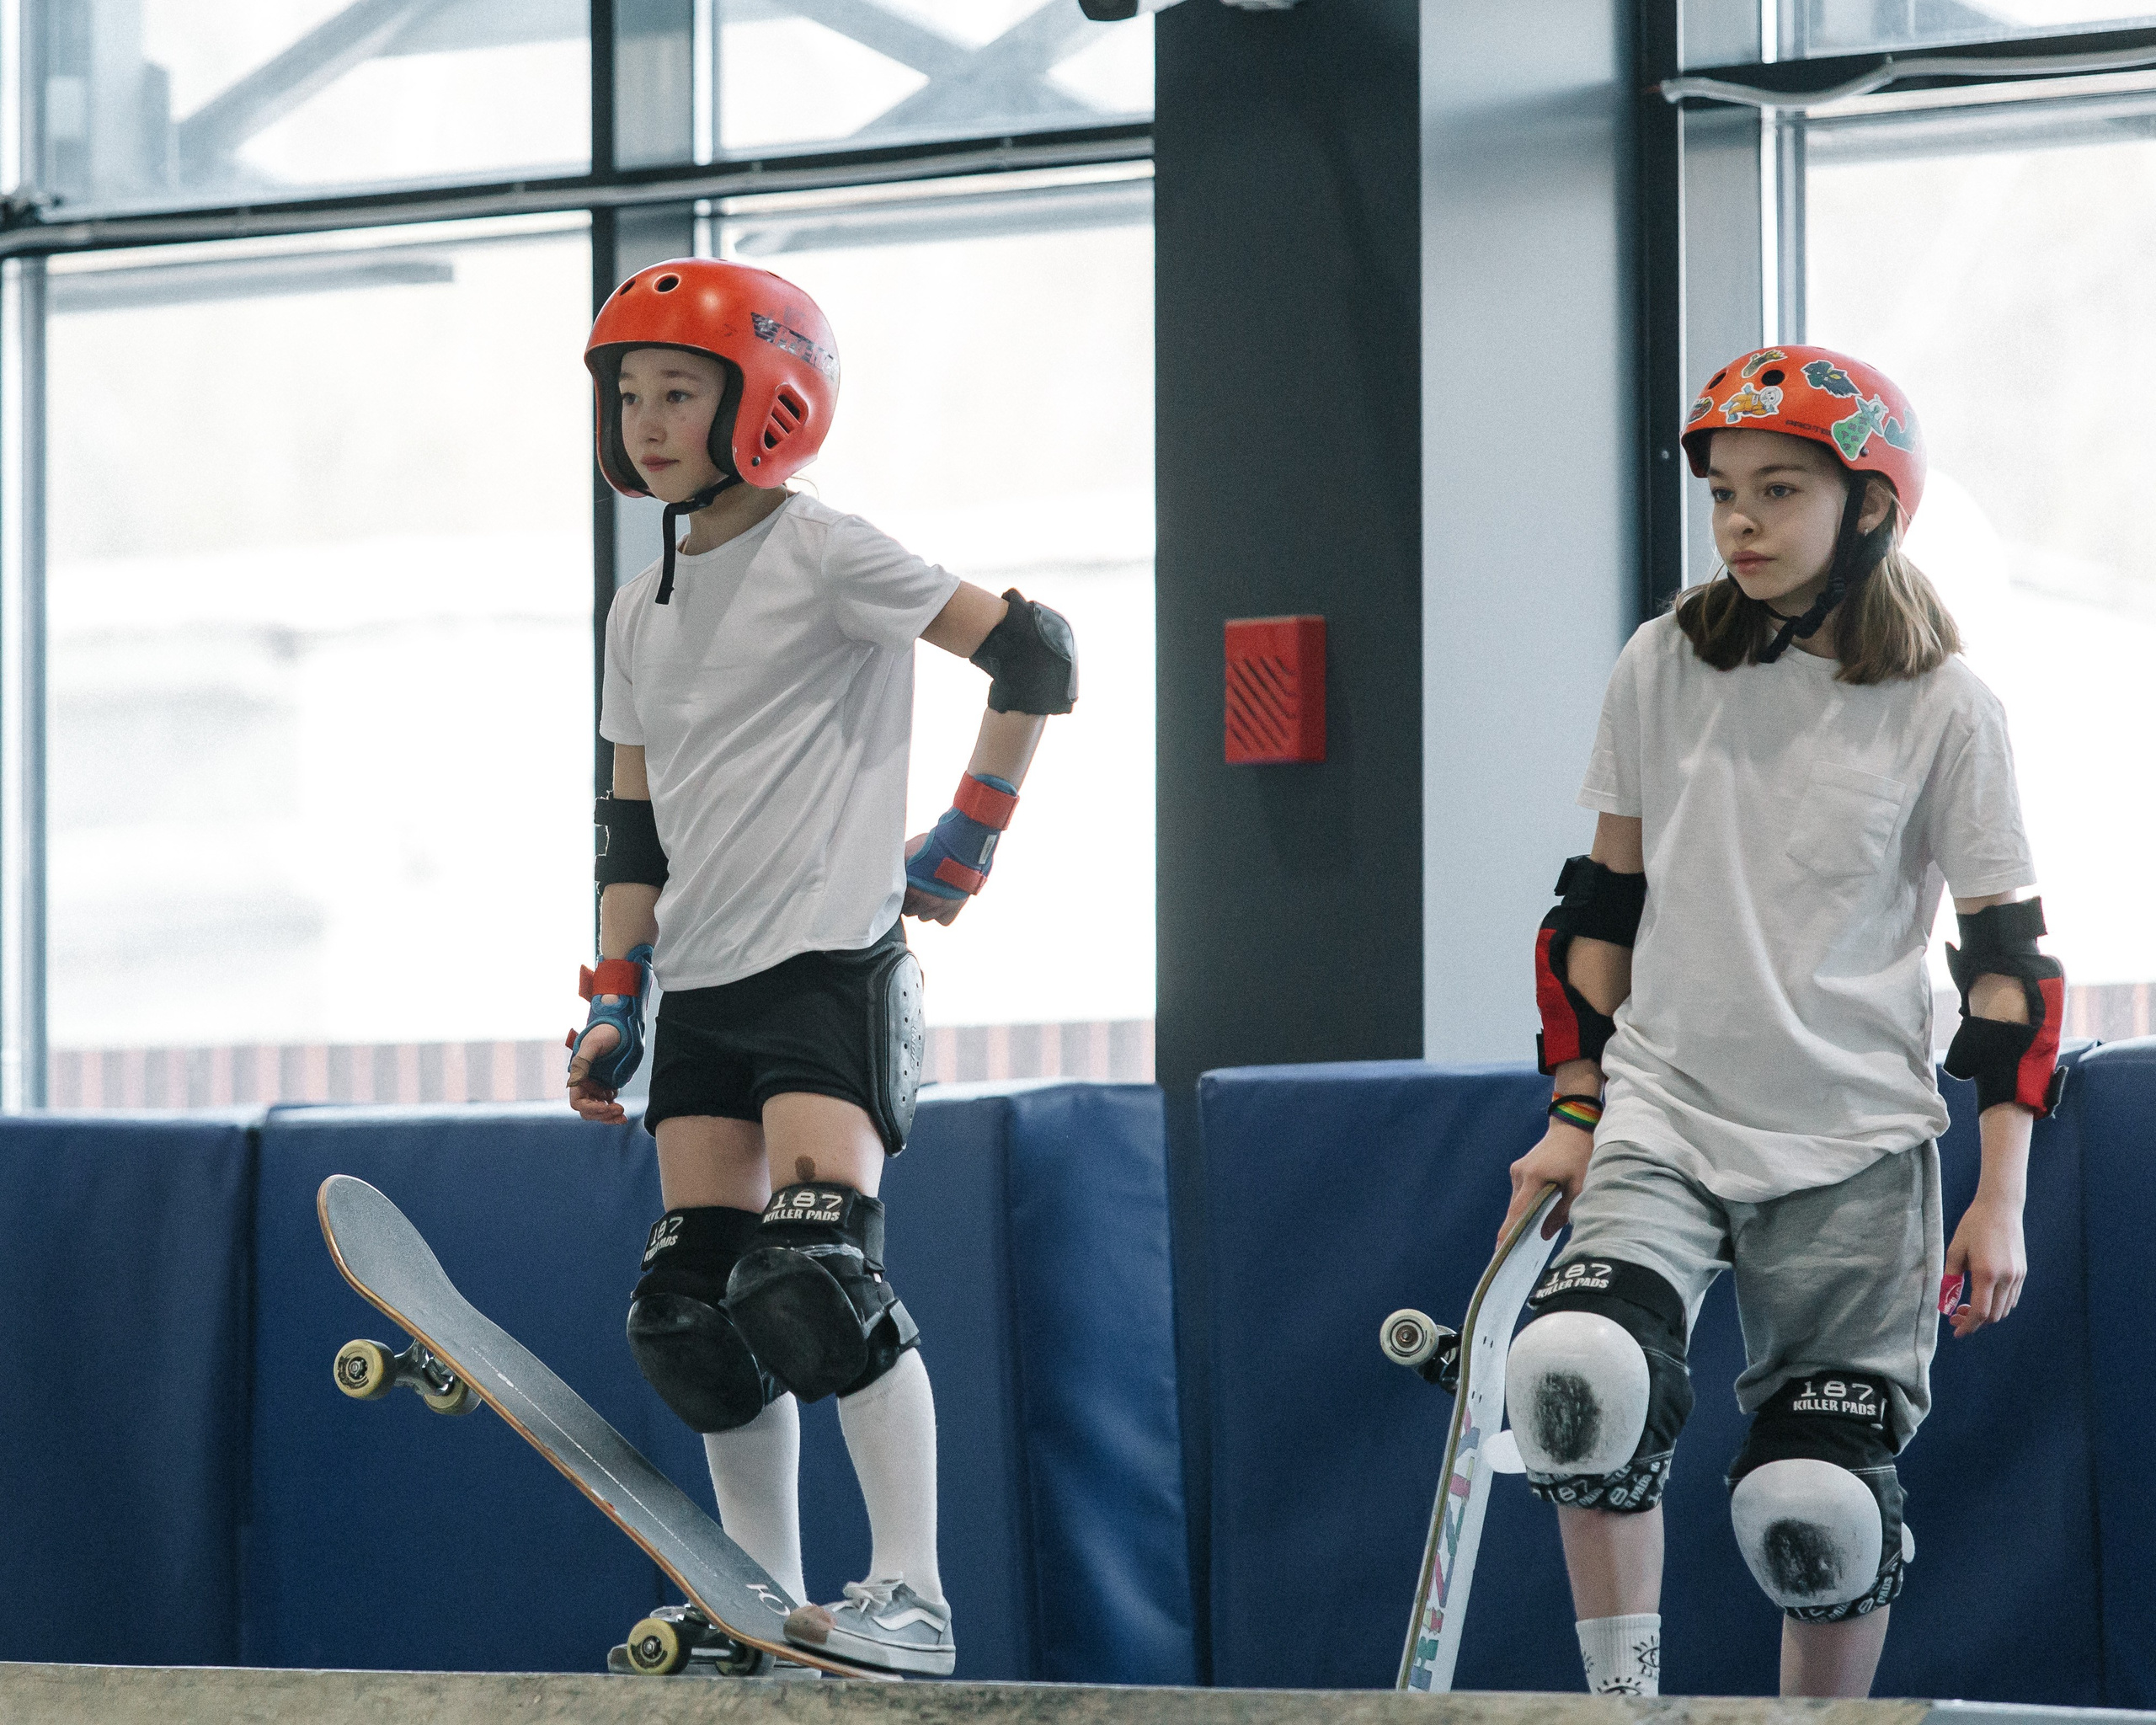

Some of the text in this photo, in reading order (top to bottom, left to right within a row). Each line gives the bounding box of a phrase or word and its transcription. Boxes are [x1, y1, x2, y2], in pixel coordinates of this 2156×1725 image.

[772, 1191, 843, 1210] 187
[761, 1209, 841, 1224] KILLER PADS
[650, 1216, 684, 1247] 187
[1546, 1263, 1613, 1287] 187
[1534, 1277, 1609, 1299] KILLER PADS
[1801, 1381, 1874, 1401] 187
[1793, 1398, 1877, 1416] KILLER PADS
